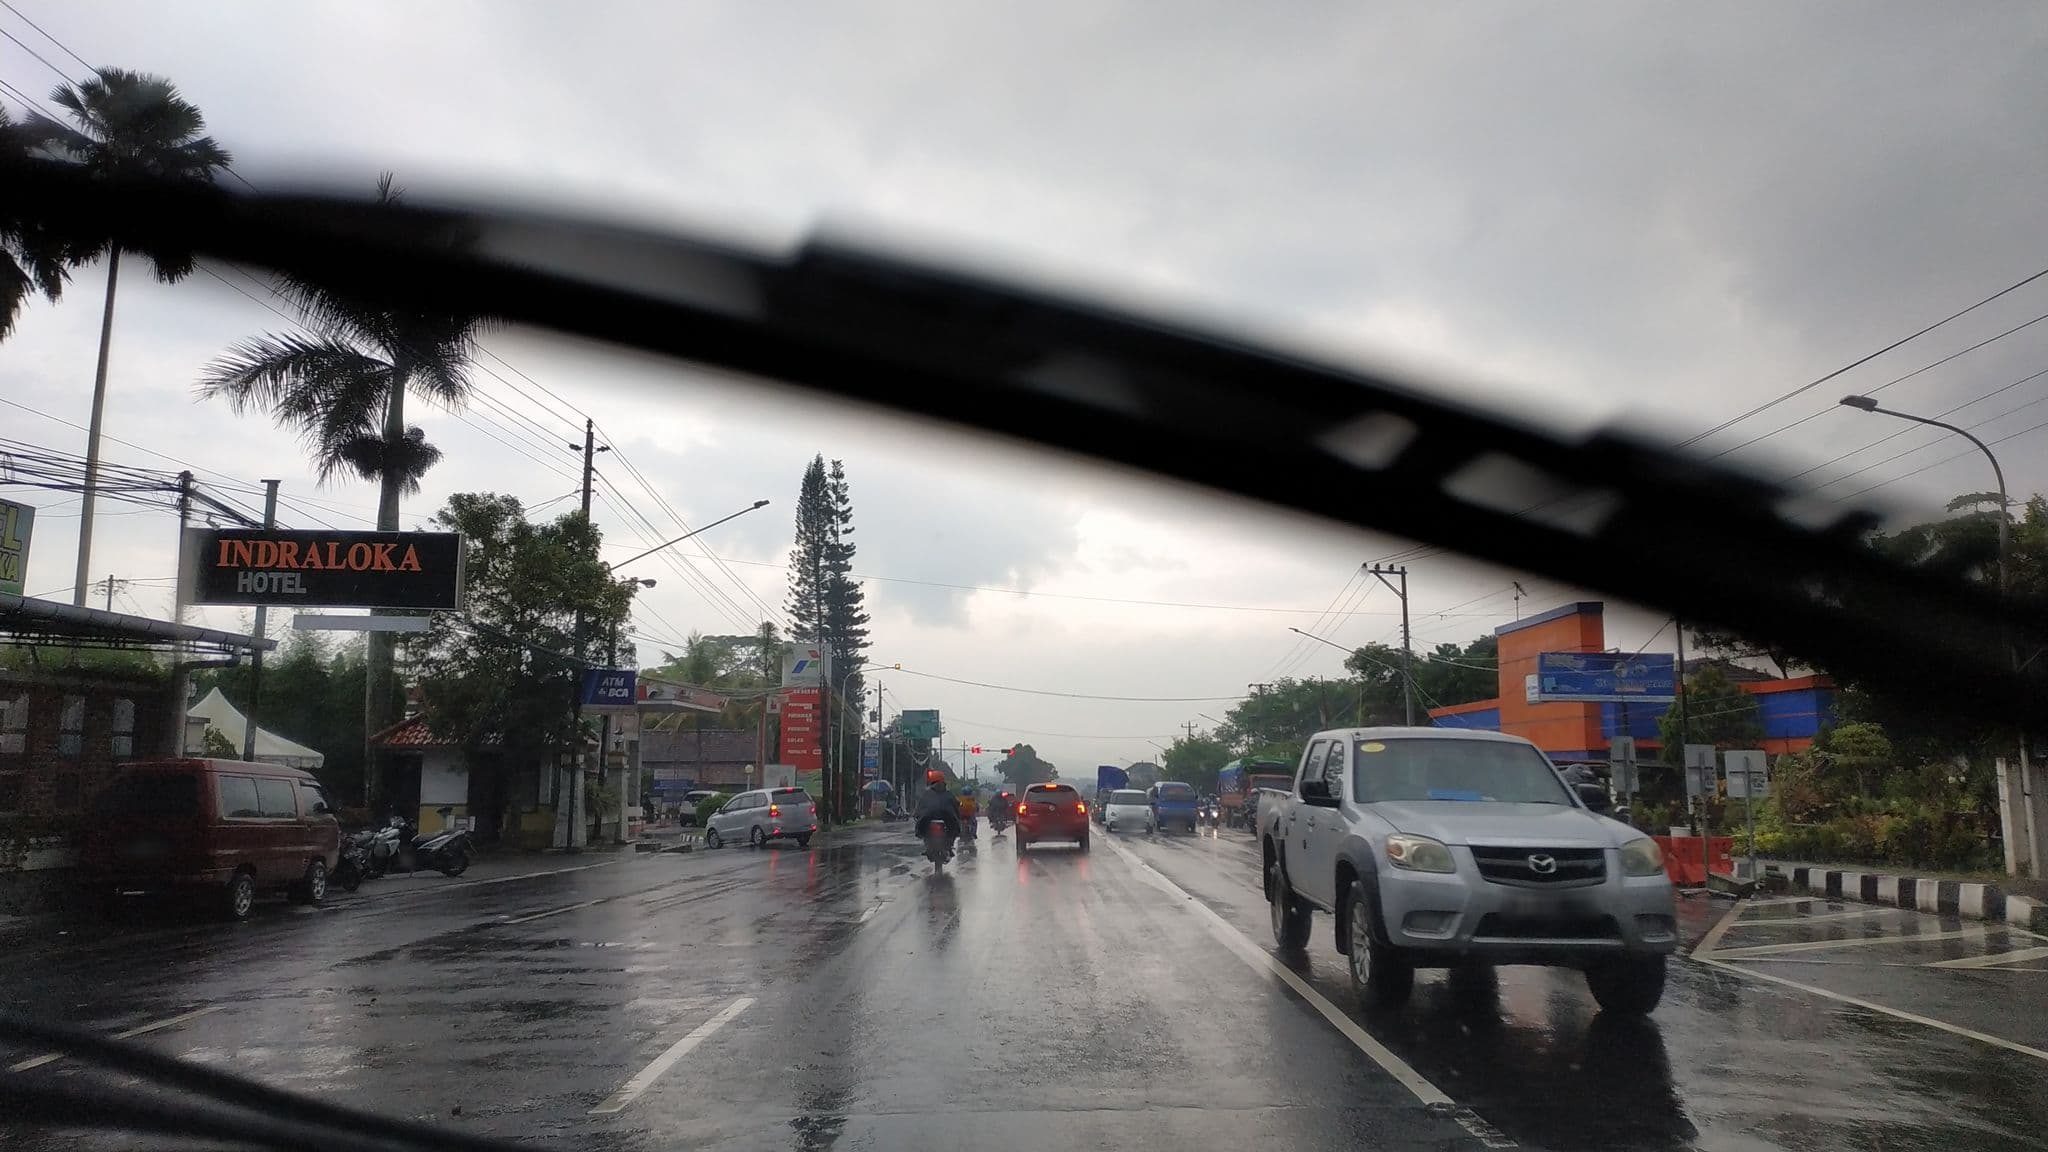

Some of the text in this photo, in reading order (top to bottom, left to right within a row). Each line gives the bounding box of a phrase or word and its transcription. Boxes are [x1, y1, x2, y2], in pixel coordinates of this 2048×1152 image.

[217, 539, 422, 572] INDRALOKA
[237, 571, 307, 594] HOTEL
[602, 677, 625, 687] ATM
[608, 688, 629, 698] BCA
